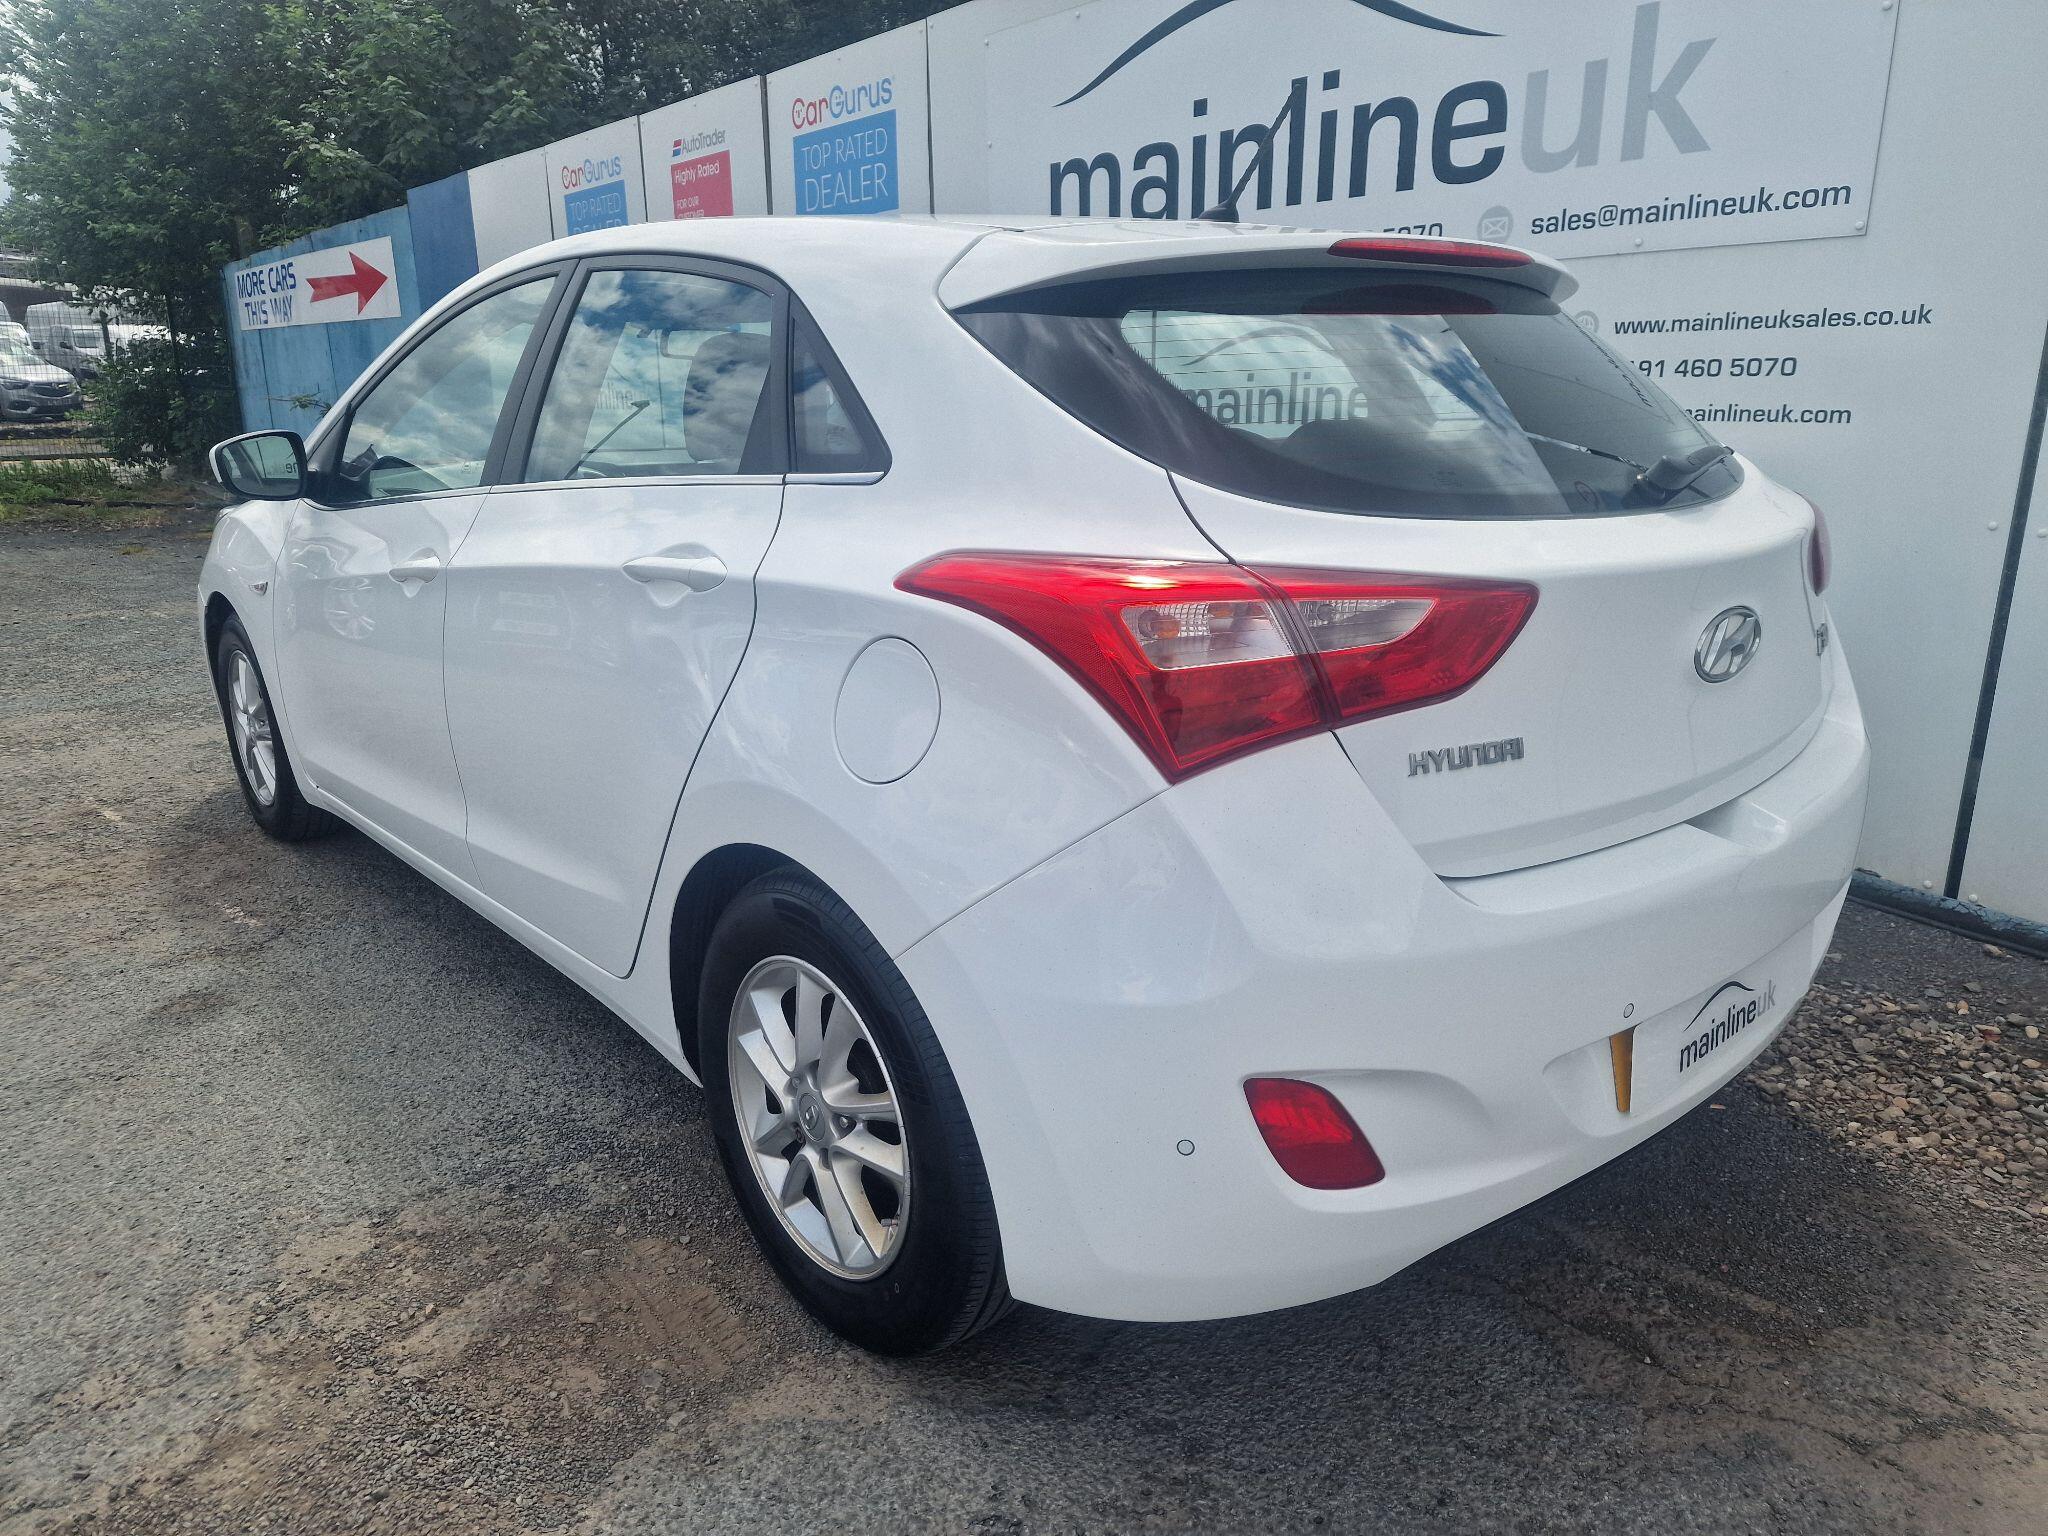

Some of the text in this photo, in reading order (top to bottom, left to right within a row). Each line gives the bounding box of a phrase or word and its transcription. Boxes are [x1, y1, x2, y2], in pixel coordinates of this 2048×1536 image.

[792, 77, 893, 129] CarGurus
[1050, 1, 1718, 219] mainlineuk
[682, 128, 726, 153] AutoTrader
[801, 128, 888, 171] TOP RATED
[561, 156, 622, 189] CarGurus
[675, 160, 720, 185] Highly Rated
[805, 163, 888, 211] DEALER
[569, 193, 621, 221] TOP RATED
[1531, 184, 1851, 235] sales@mainlineuk.com
[236, 261, 297, 300] MORE CARS
[245, 294, 293, 325] THIS WAY
[1614, 304, 1932, 335] www.mainlineuksales.co.uk
[1674, 358, 1722, 378] 460
[1729, 357, 1798, 377] 5070
[1408, 736, 1525, 778] HYUNDAI
[1680, 979, 1776, 1073] mainlineuk
